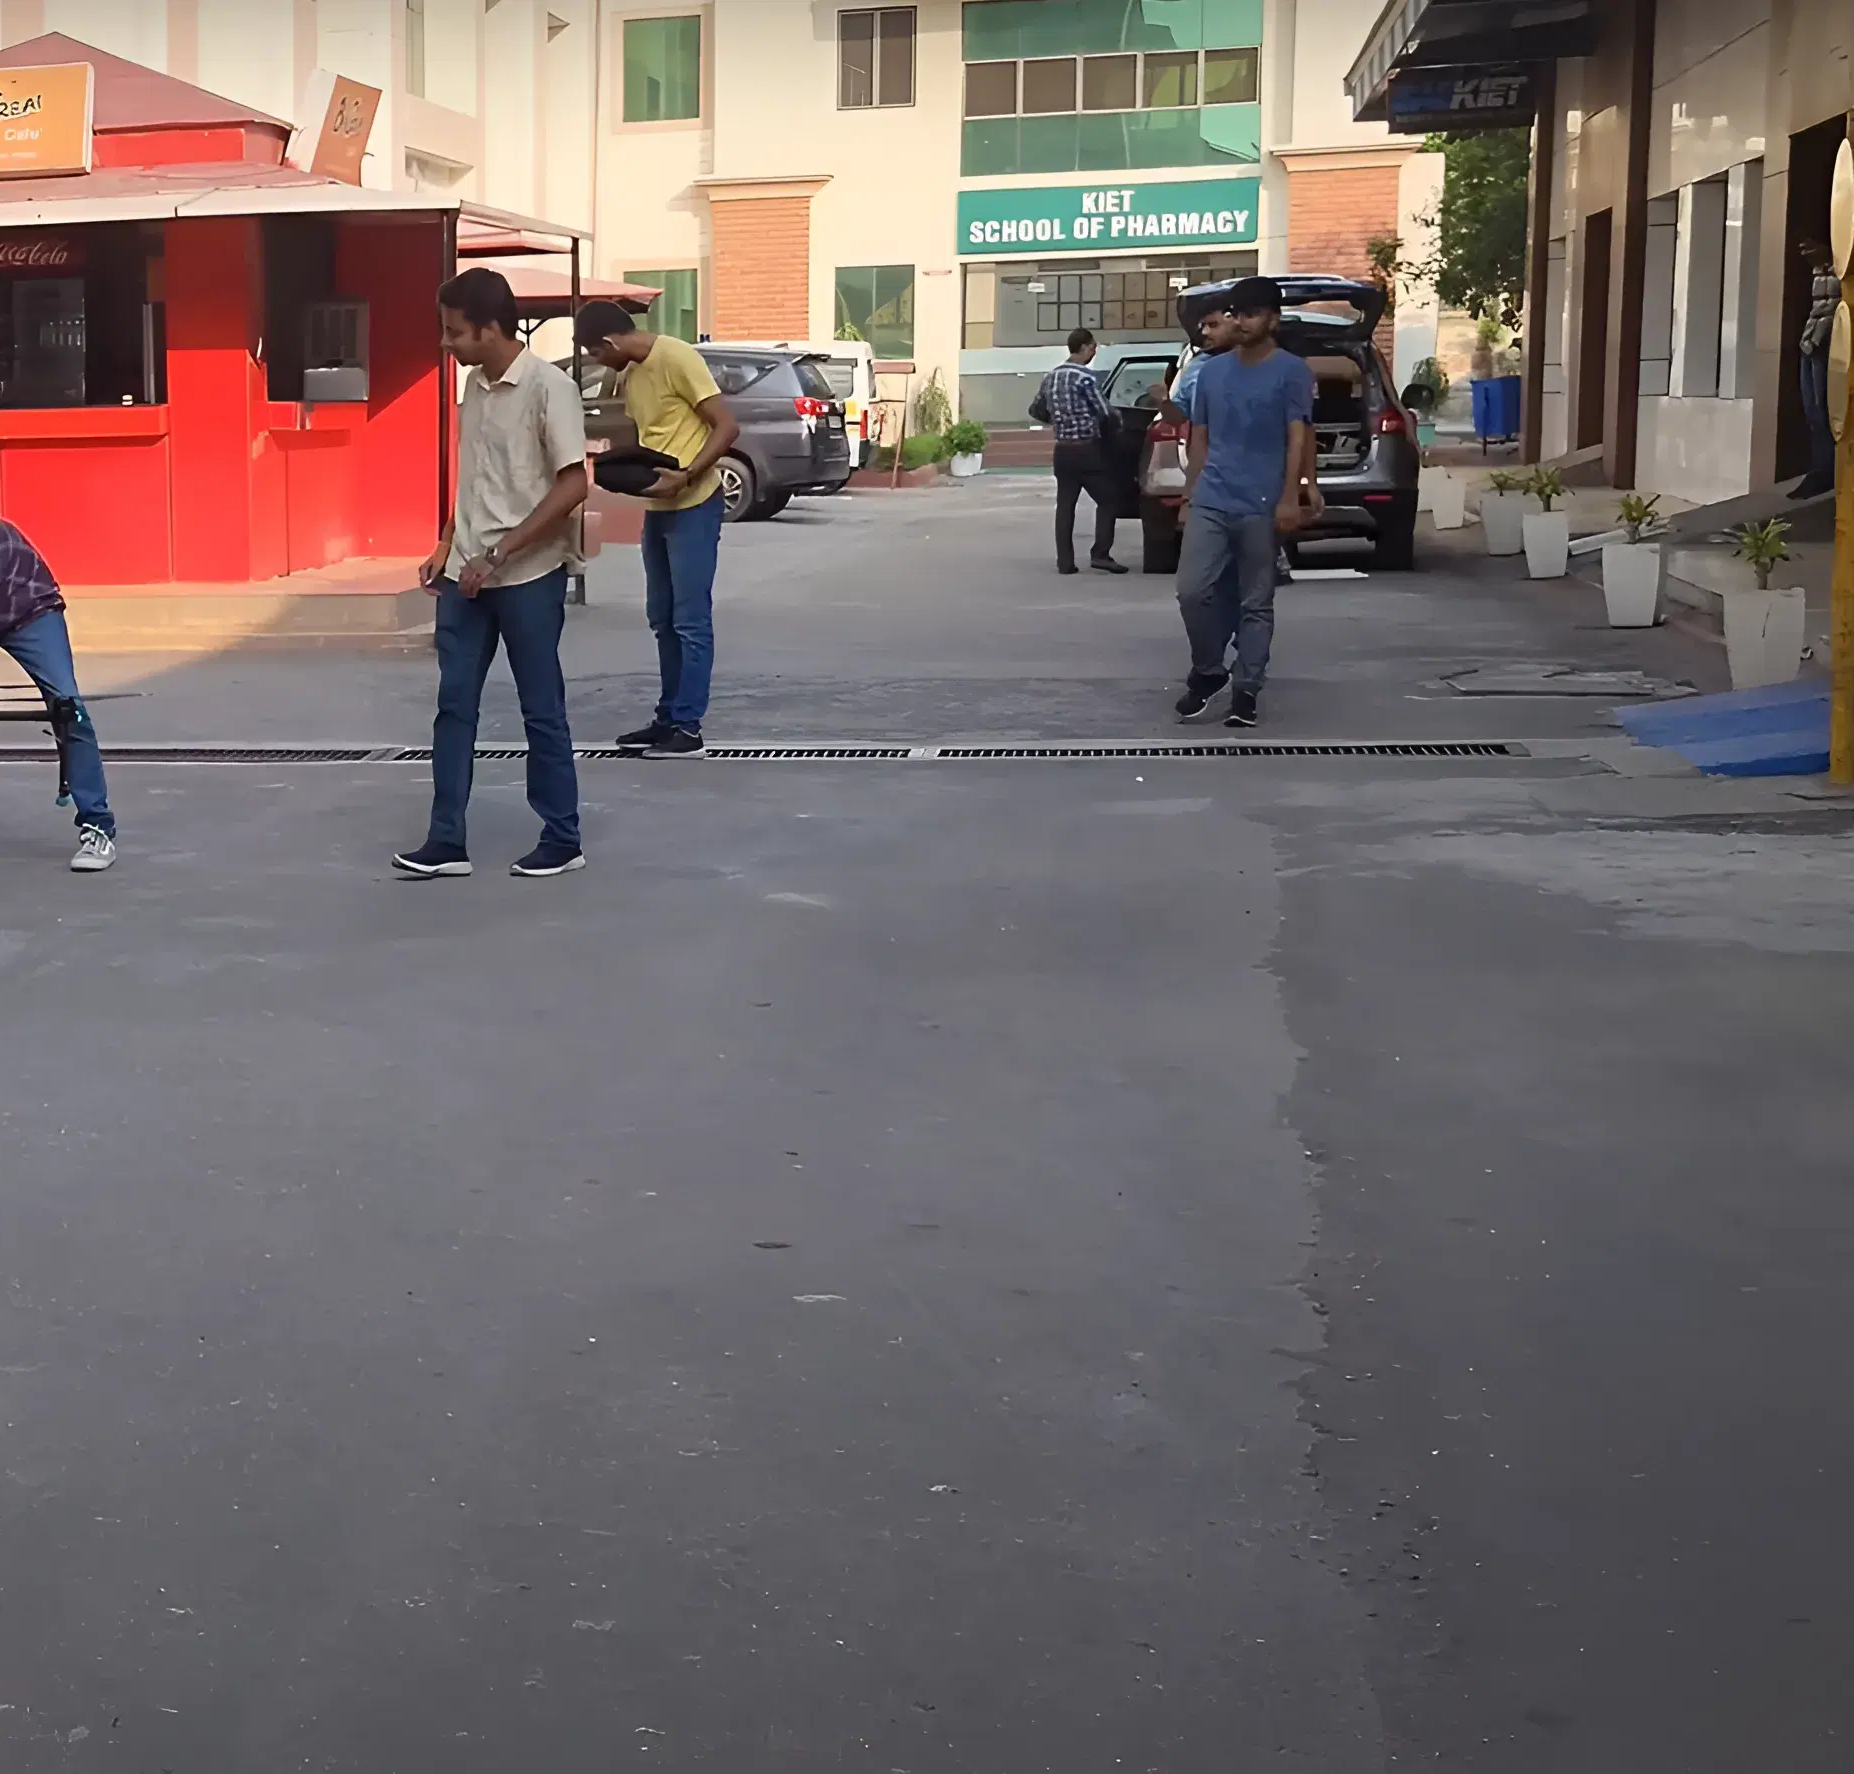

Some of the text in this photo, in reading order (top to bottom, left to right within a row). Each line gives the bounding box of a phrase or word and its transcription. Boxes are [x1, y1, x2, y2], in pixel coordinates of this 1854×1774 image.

[1449, 75, 1530, 110] KIET
[1082, 190, 1135, 214] KIET
[969, 210, 1250, 244] SCHOOL OF PHARMACY
